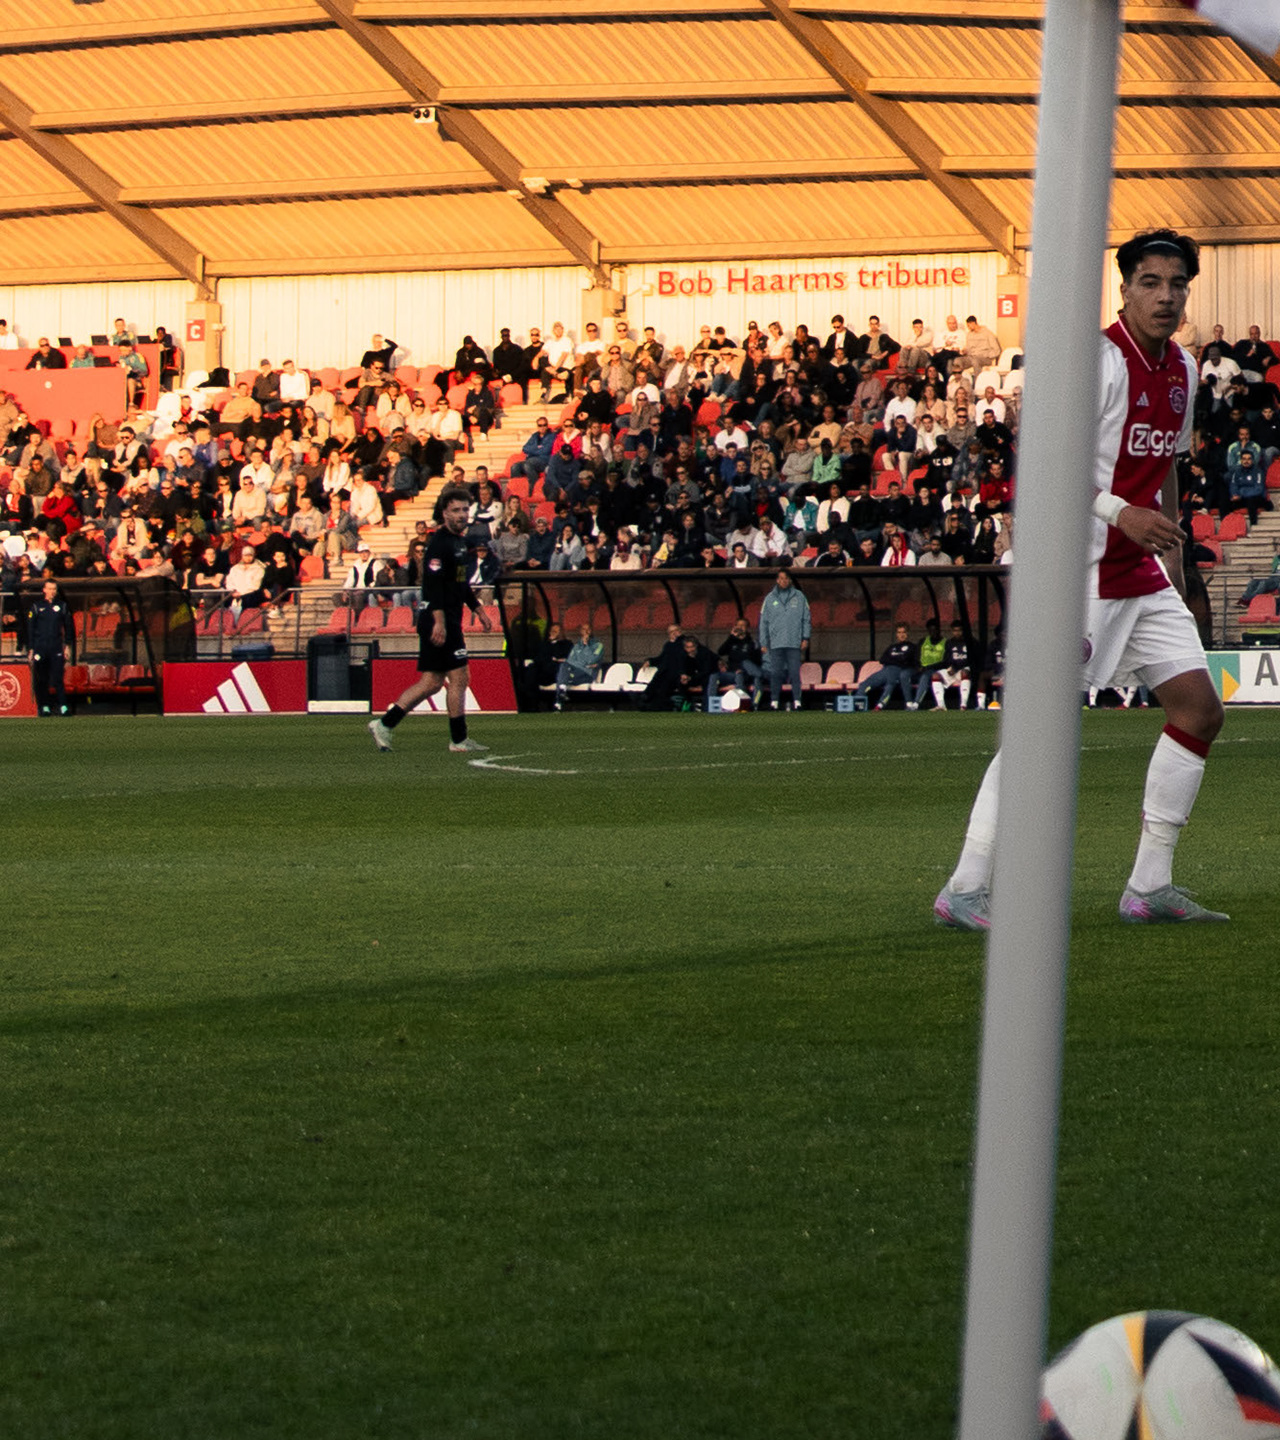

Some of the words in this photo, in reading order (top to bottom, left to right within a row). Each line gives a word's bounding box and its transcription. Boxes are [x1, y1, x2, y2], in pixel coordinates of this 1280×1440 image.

[658, 269, 713, 295] Bob
[727, 268, 846, 294] Haarms
[858, 262, 968, 288] tribune
[1002, 300, 1013, 315] B
[191, 325, 201, 339] C
